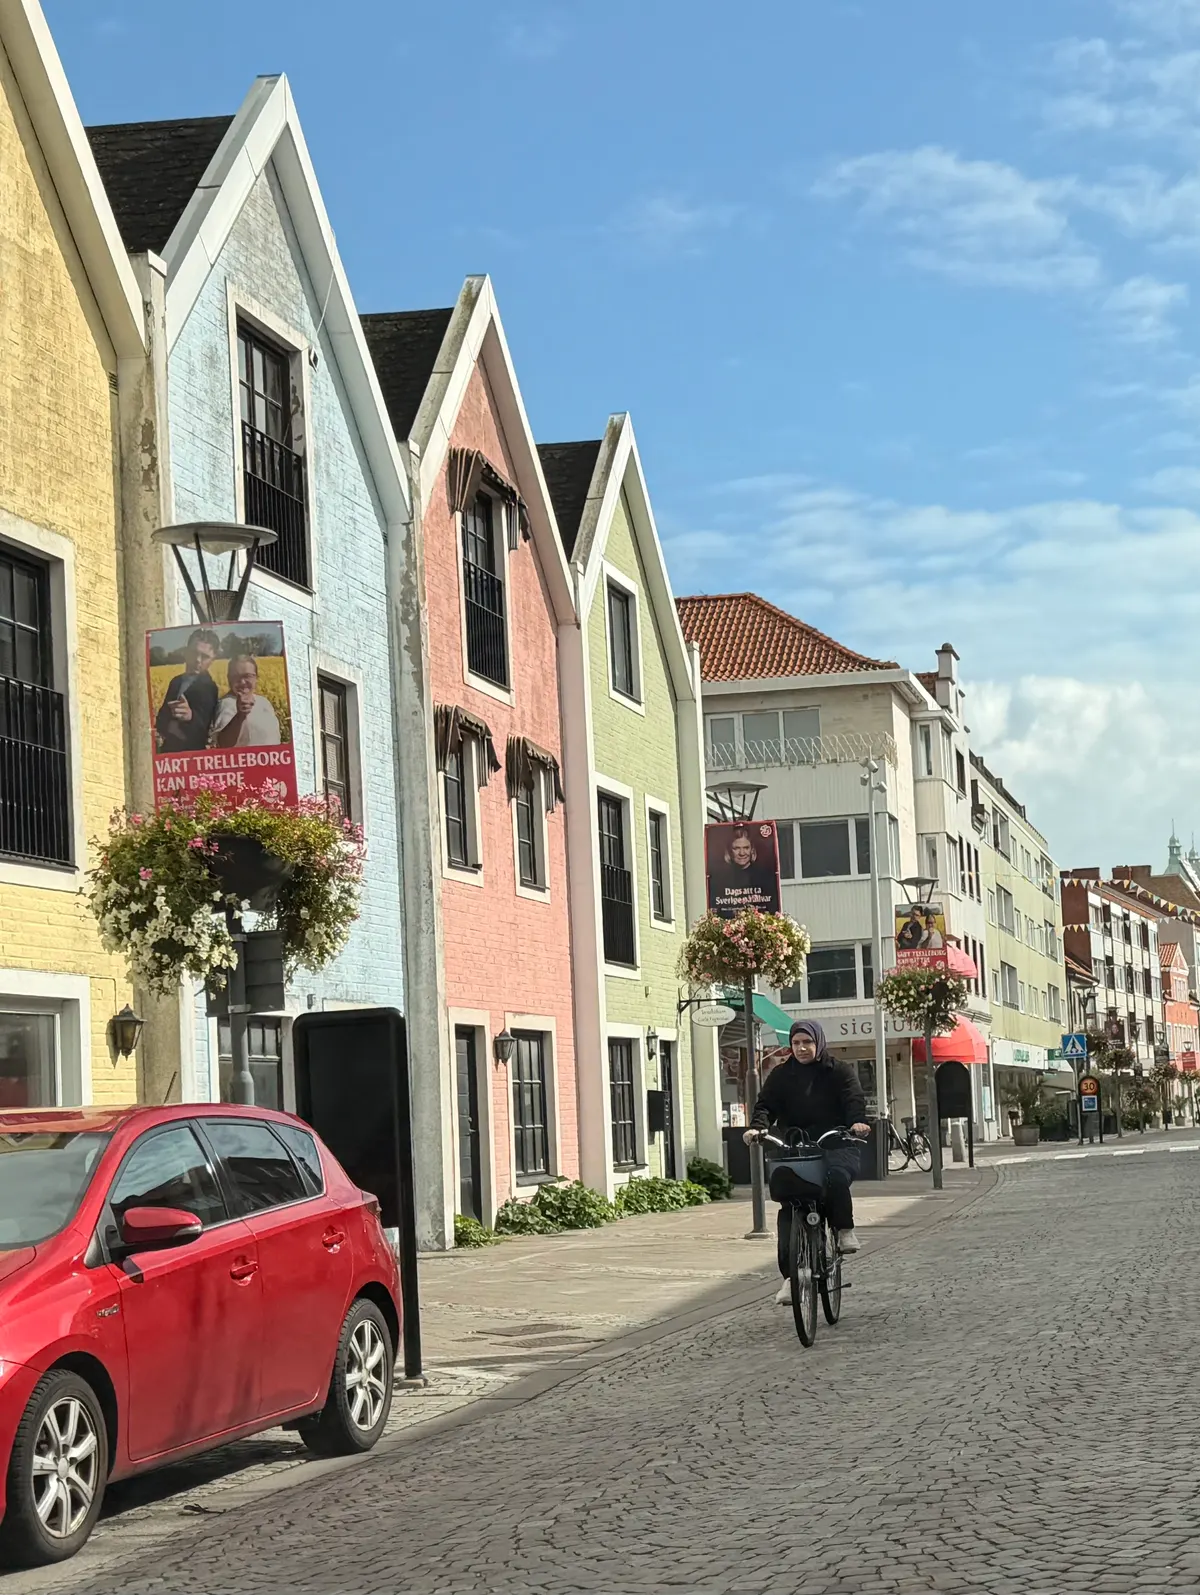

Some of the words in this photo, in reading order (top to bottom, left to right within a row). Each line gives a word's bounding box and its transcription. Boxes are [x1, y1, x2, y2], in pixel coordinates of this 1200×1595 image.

[155, 757, 191, 774] VÅRT
[193, 750, 292, 771] TRELLEBORG
[156, 775, 186, 792] KAN
[188, 771, 245, 790] BTTRE
[724, 887, 742, 897] Dags
[715, 895, 741, 905] Sverige
[1083, 1082, 1095, 1091] 30
